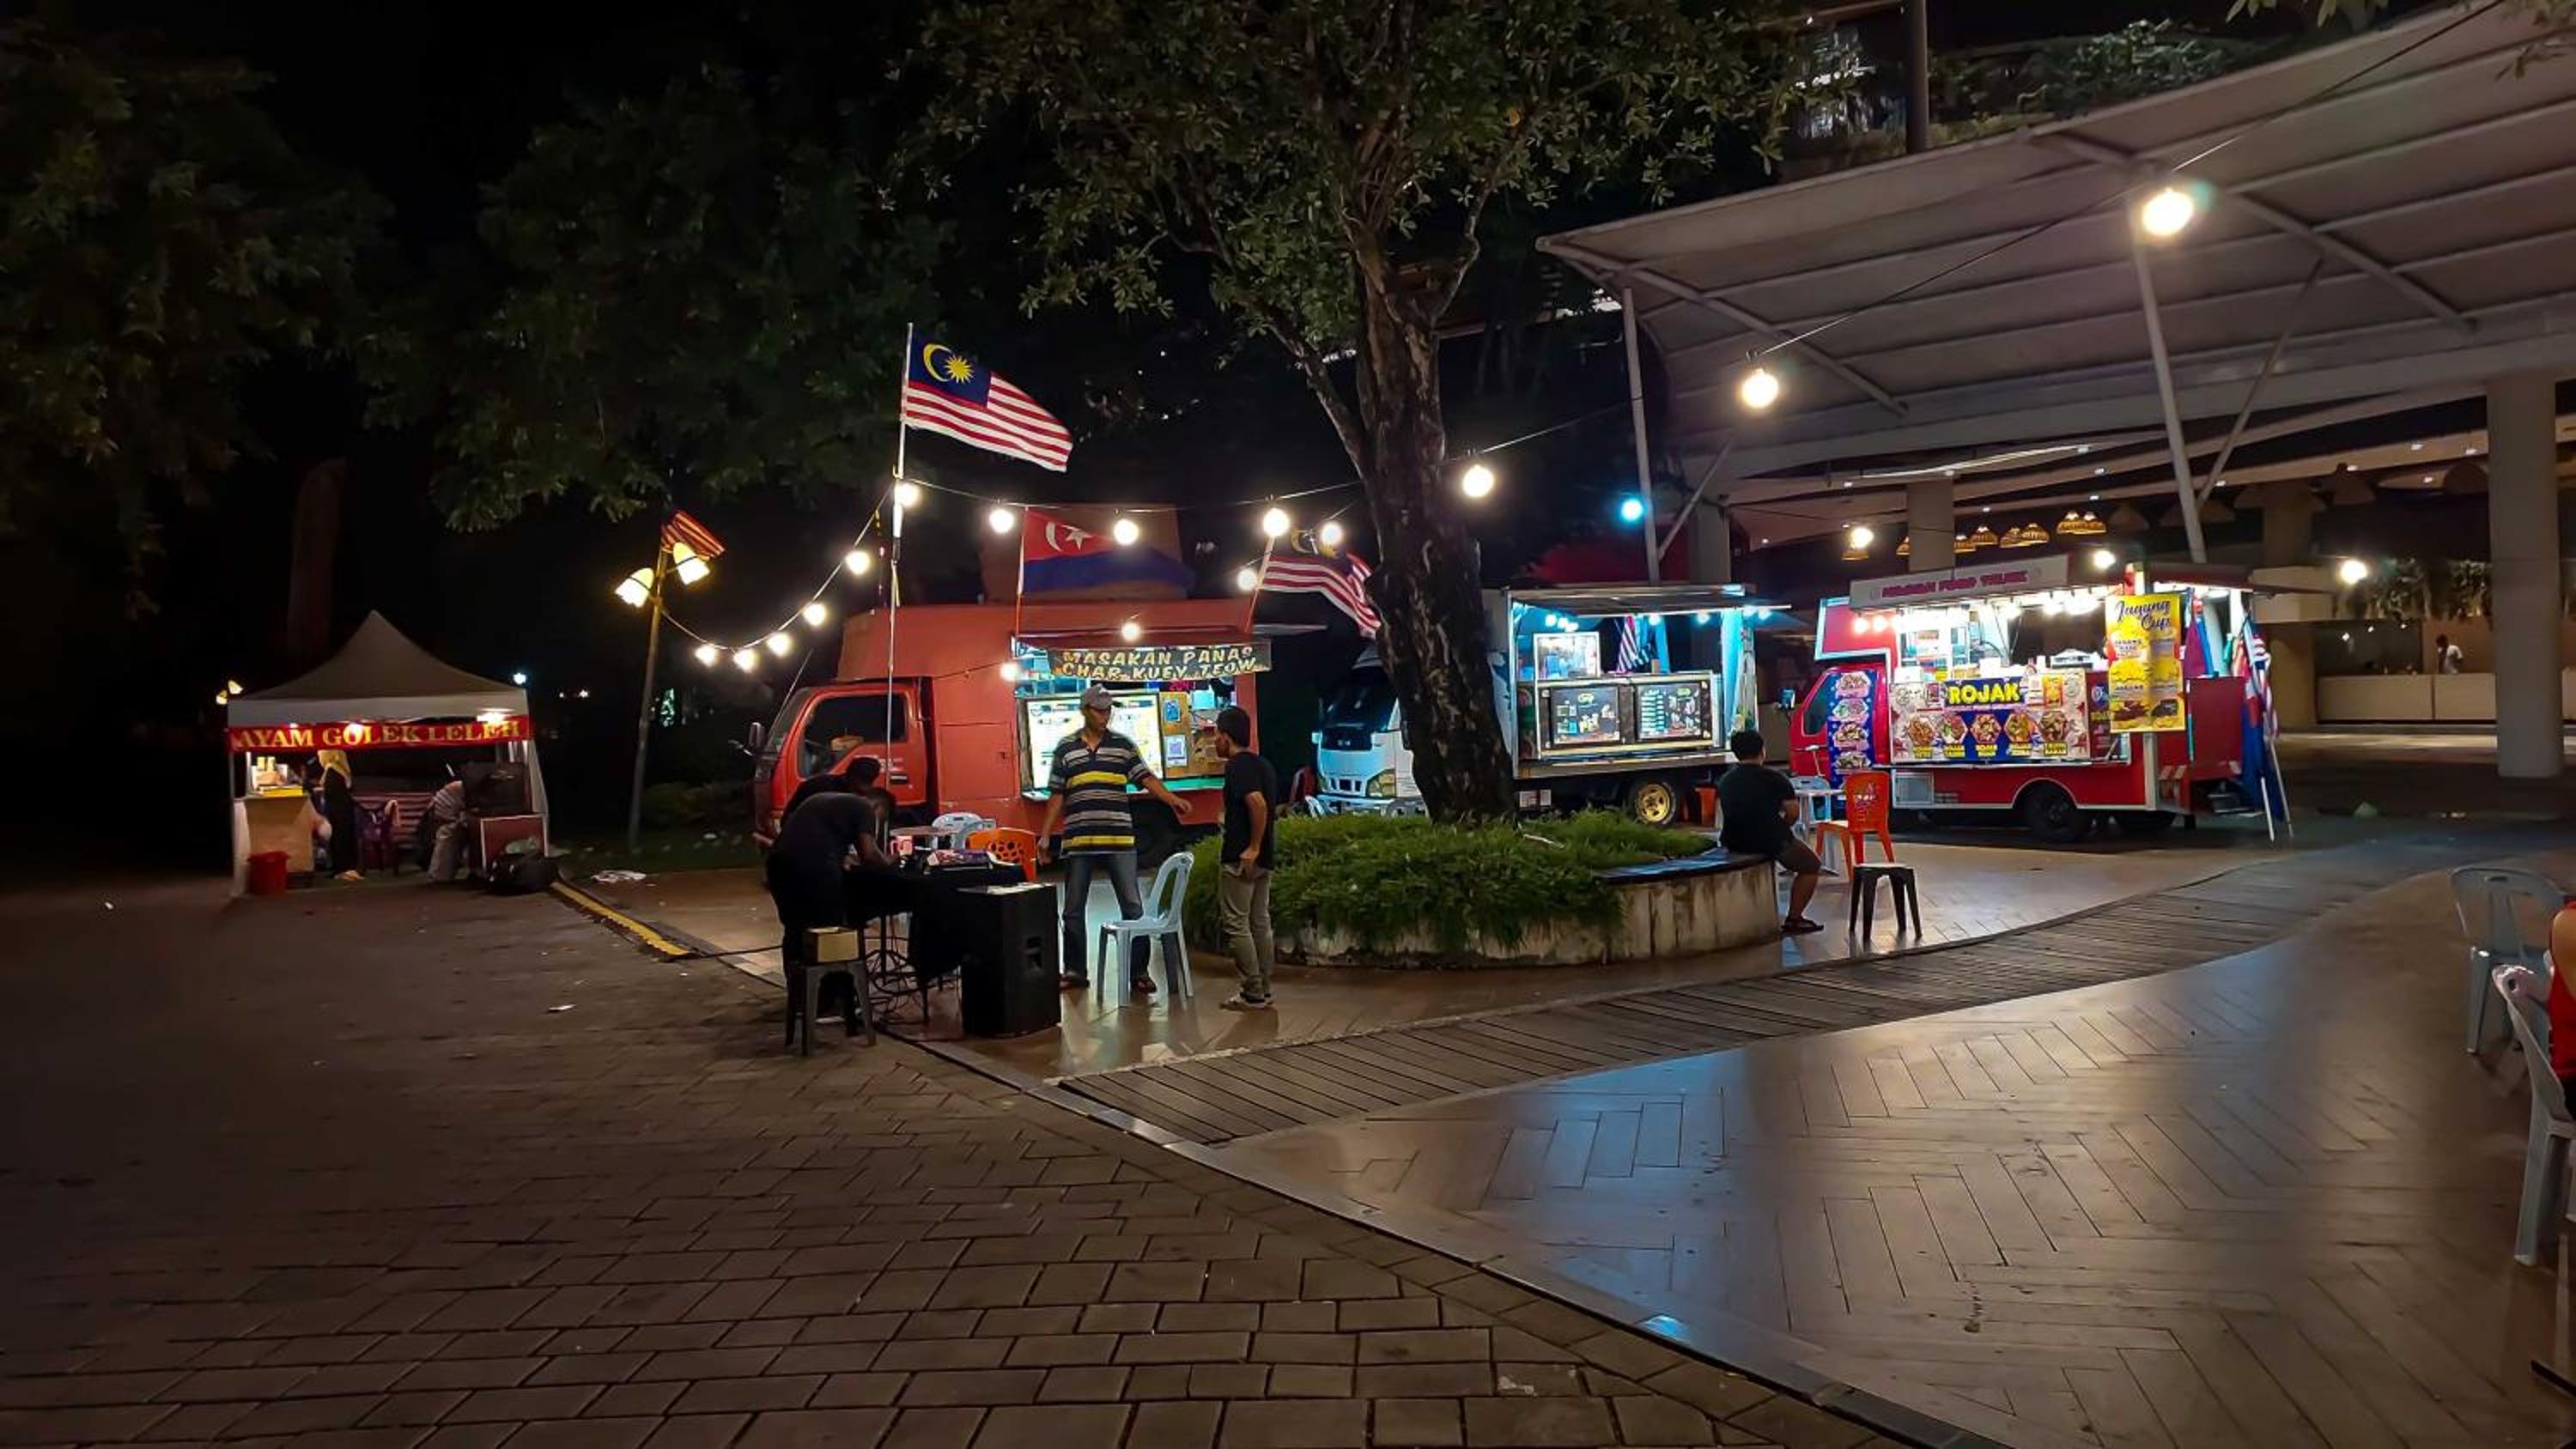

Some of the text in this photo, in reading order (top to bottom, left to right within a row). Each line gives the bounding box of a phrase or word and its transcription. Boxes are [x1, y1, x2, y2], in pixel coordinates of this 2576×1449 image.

[1062, 646, 1254, 665] MASAKAN PANAS
[1062, 657, 1256, 680] CHAR KUEY TEOW
[1948, 682, 2020, 705] ROJAK
[234, 728, 315, 748] AYAM
[322, 724, 422, 746] GOLEK
